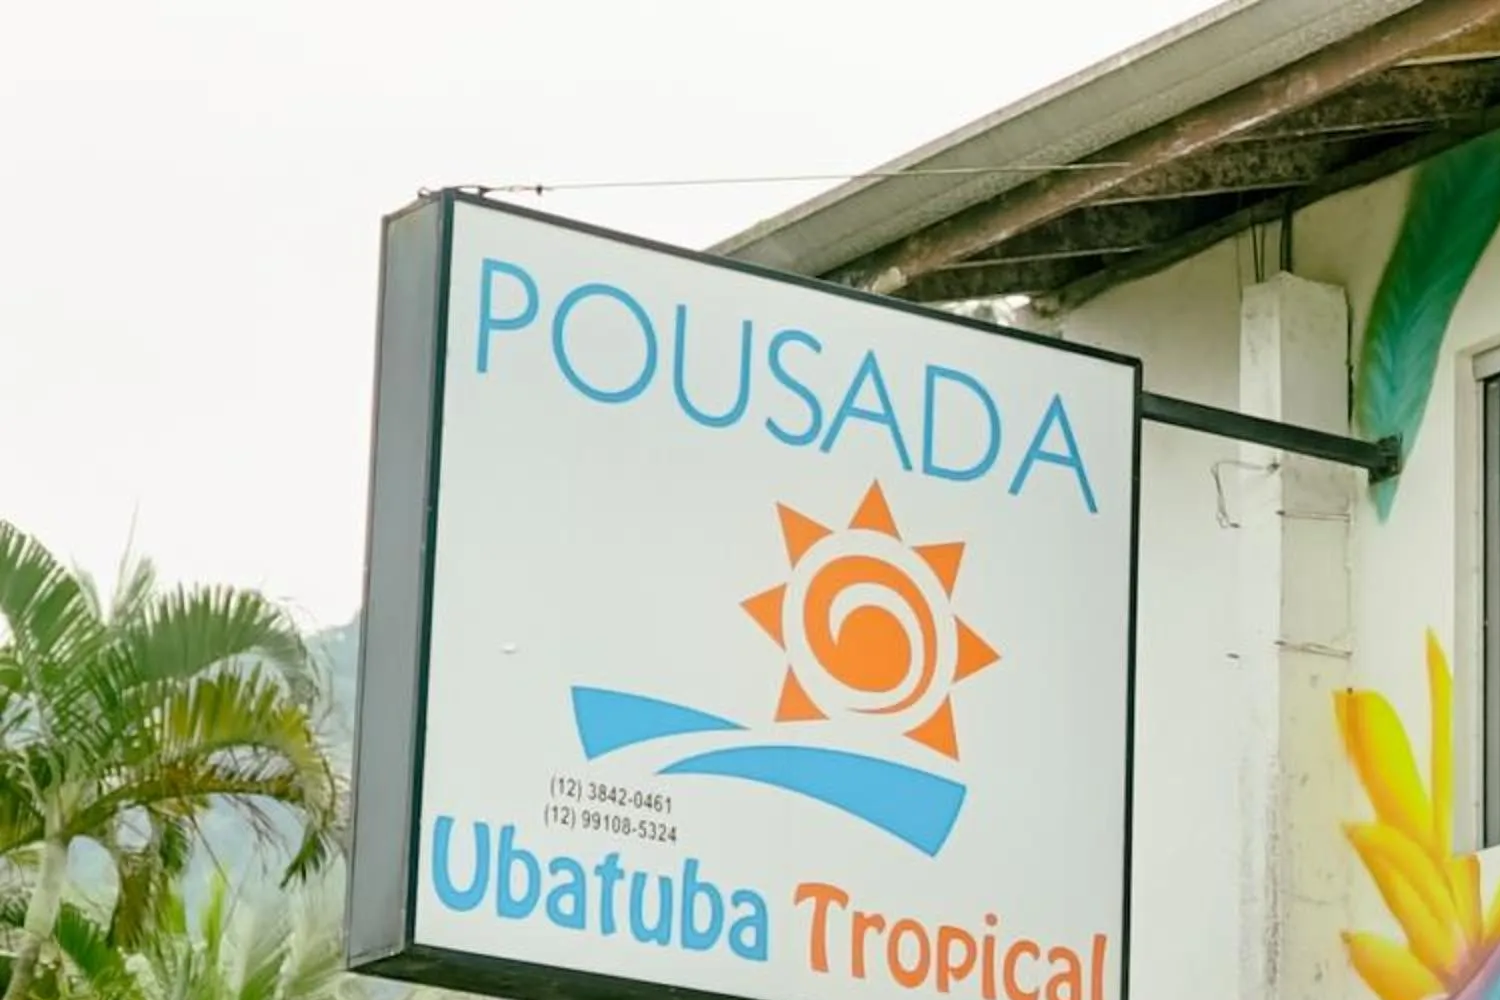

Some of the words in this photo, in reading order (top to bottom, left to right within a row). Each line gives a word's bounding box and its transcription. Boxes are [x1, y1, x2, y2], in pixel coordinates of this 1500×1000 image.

[475, 257, 1099, 514] POUSADA
[544, 804, 577, 829] (12)
[582, 810, 678, 842] 99108-5324
[550, 776, 582, 802] (12)
[588, 782, 672, 814] 3842-0461
[431, 815, 769, 962] Ubatuba
